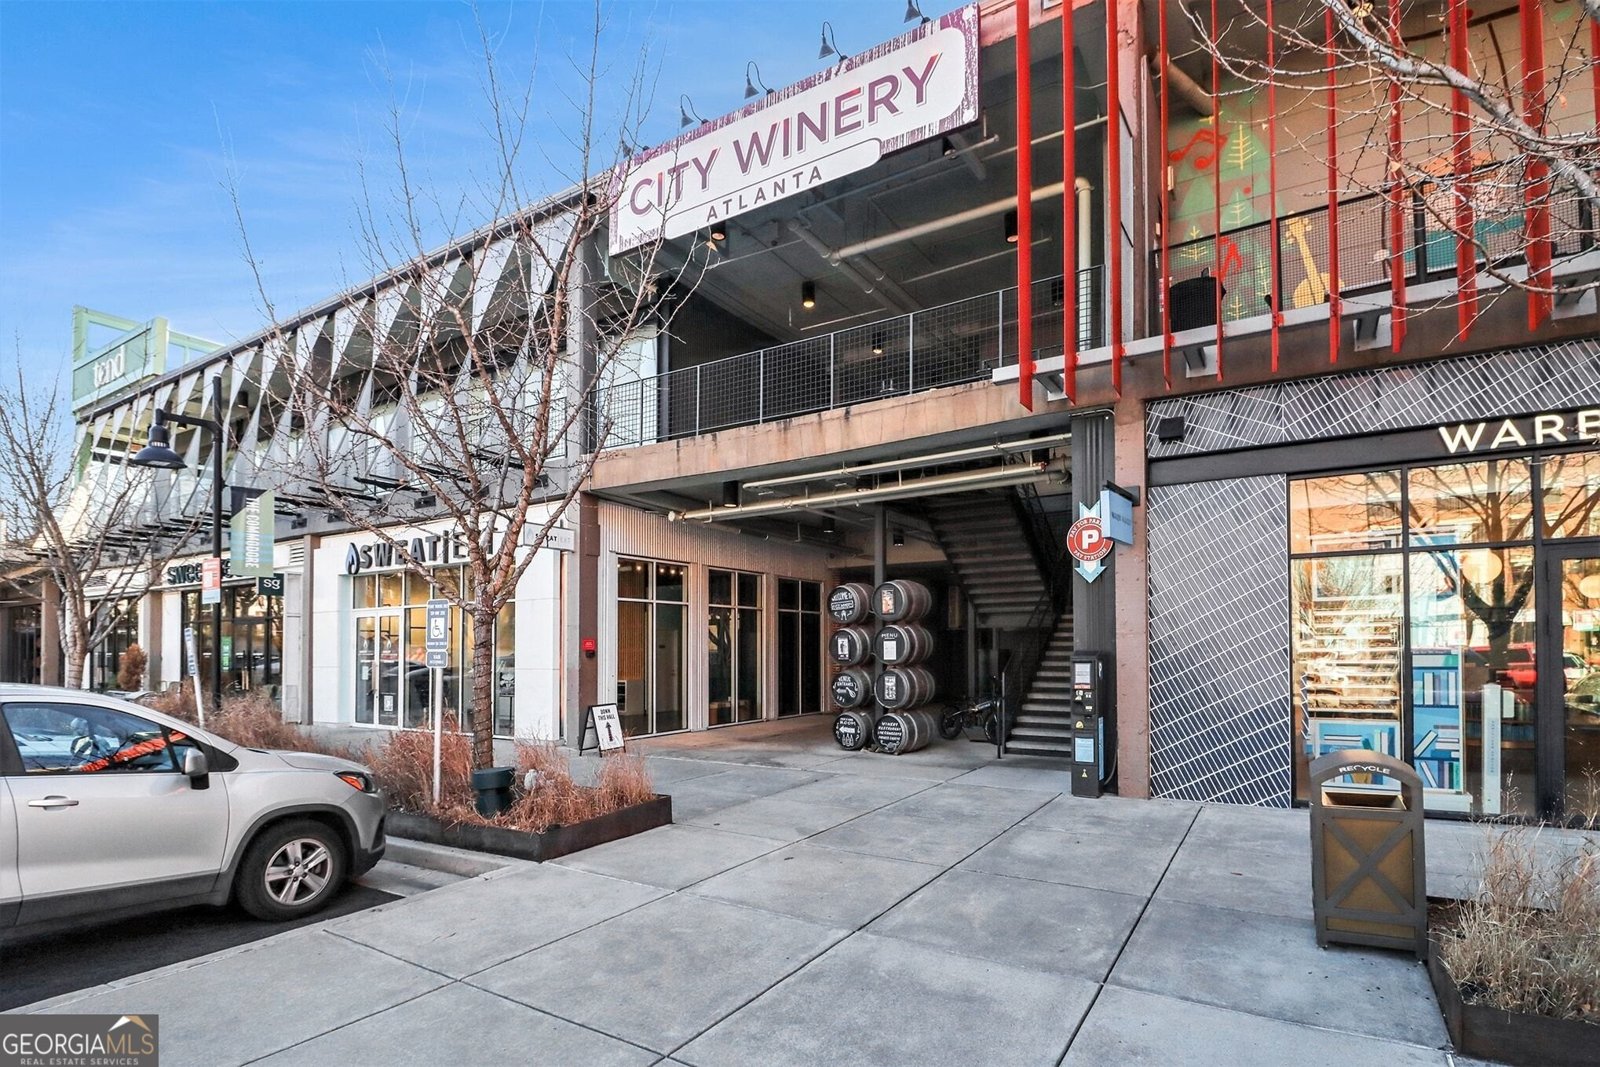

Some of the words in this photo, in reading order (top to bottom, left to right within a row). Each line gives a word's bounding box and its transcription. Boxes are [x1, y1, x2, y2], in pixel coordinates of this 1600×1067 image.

[628, 145, 723, 217] CITY
[732, 50, 945, 176] WINERY
[705, 164, 823, 223] ATLANTA
[245, 514, 260, 569] COMMODORE
[1081, 529, 1100, 550] P
[1083, 547, 1108, 561] STATION
[1338, 764, 1391, 775] RECYCLE
